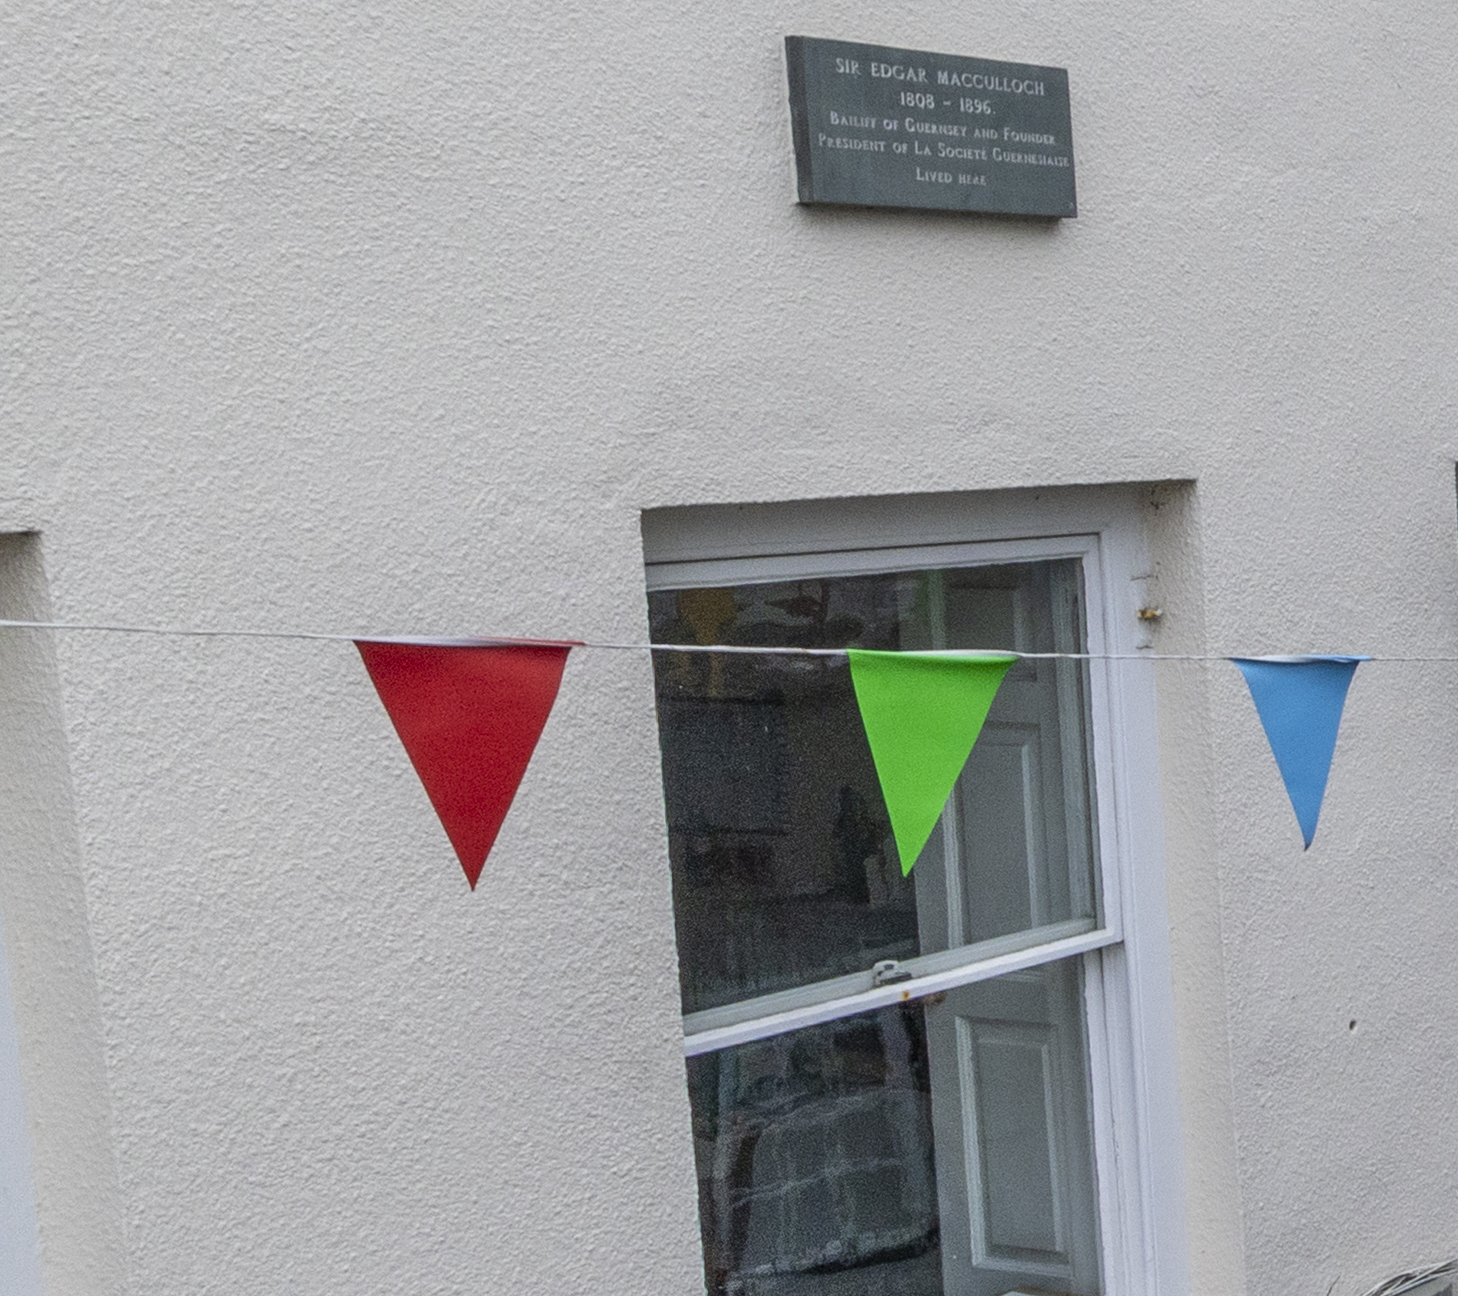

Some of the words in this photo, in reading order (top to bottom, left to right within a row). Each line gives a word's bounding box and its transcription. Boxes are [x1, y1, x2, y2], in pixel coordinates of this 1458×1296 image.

[836, 57, 861, 77] SIR
[870, 62, 929, 84] EDGAR
[937, 70, 1046, 97] MACCULLOCH
[899, 90, 936, 110] 1808
[958, 96, 997, 116] 1896.
